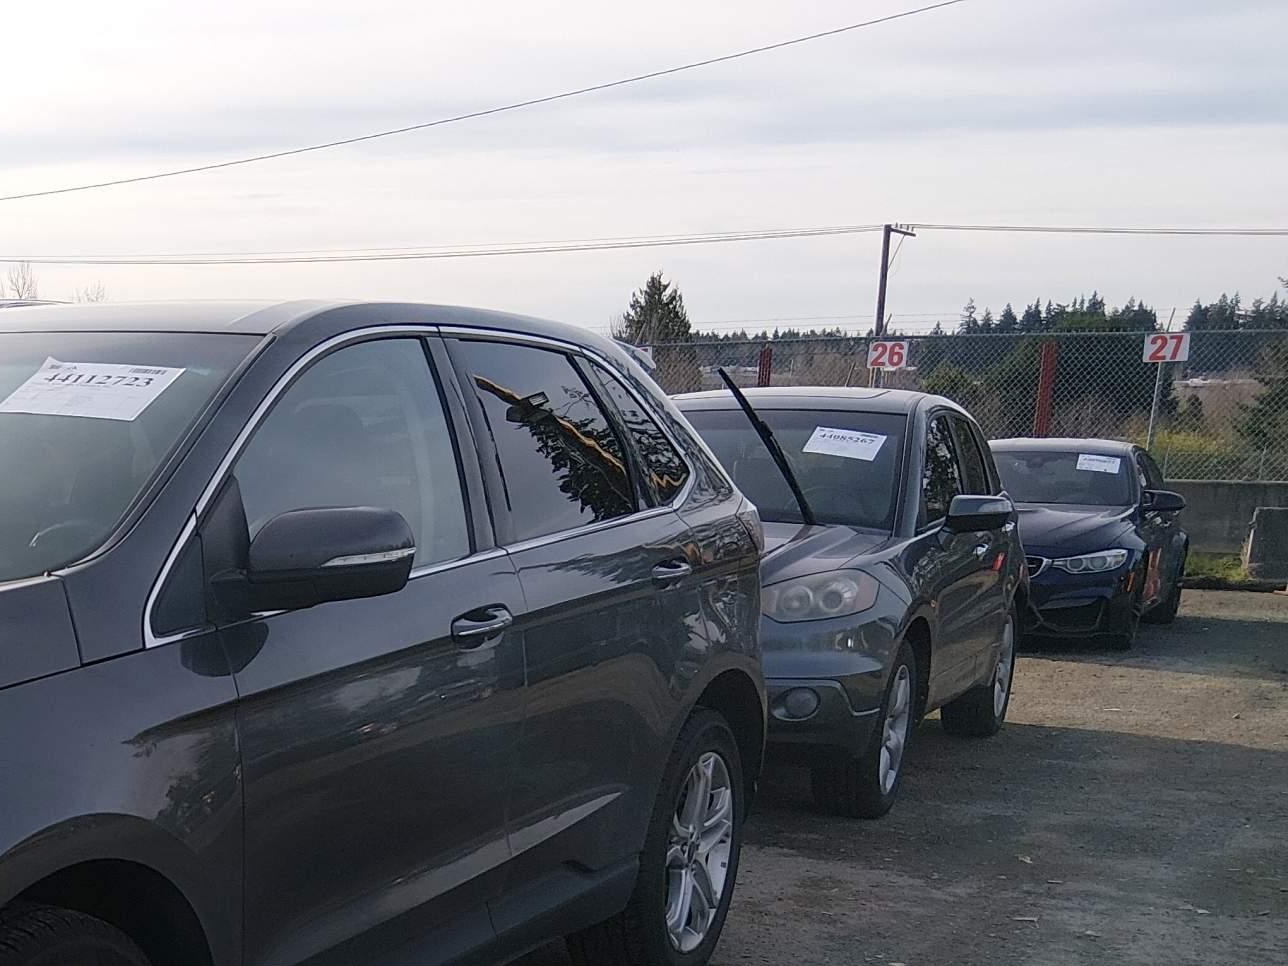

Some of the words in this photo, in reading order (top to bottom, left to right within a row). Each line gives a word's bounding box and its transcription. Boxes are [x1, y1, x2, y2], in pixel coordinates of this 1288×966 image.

[871, 342, 904, 367] 26
[1149, 335, 1184, 361] 27
[44, 372, 154, 388] 44112723
